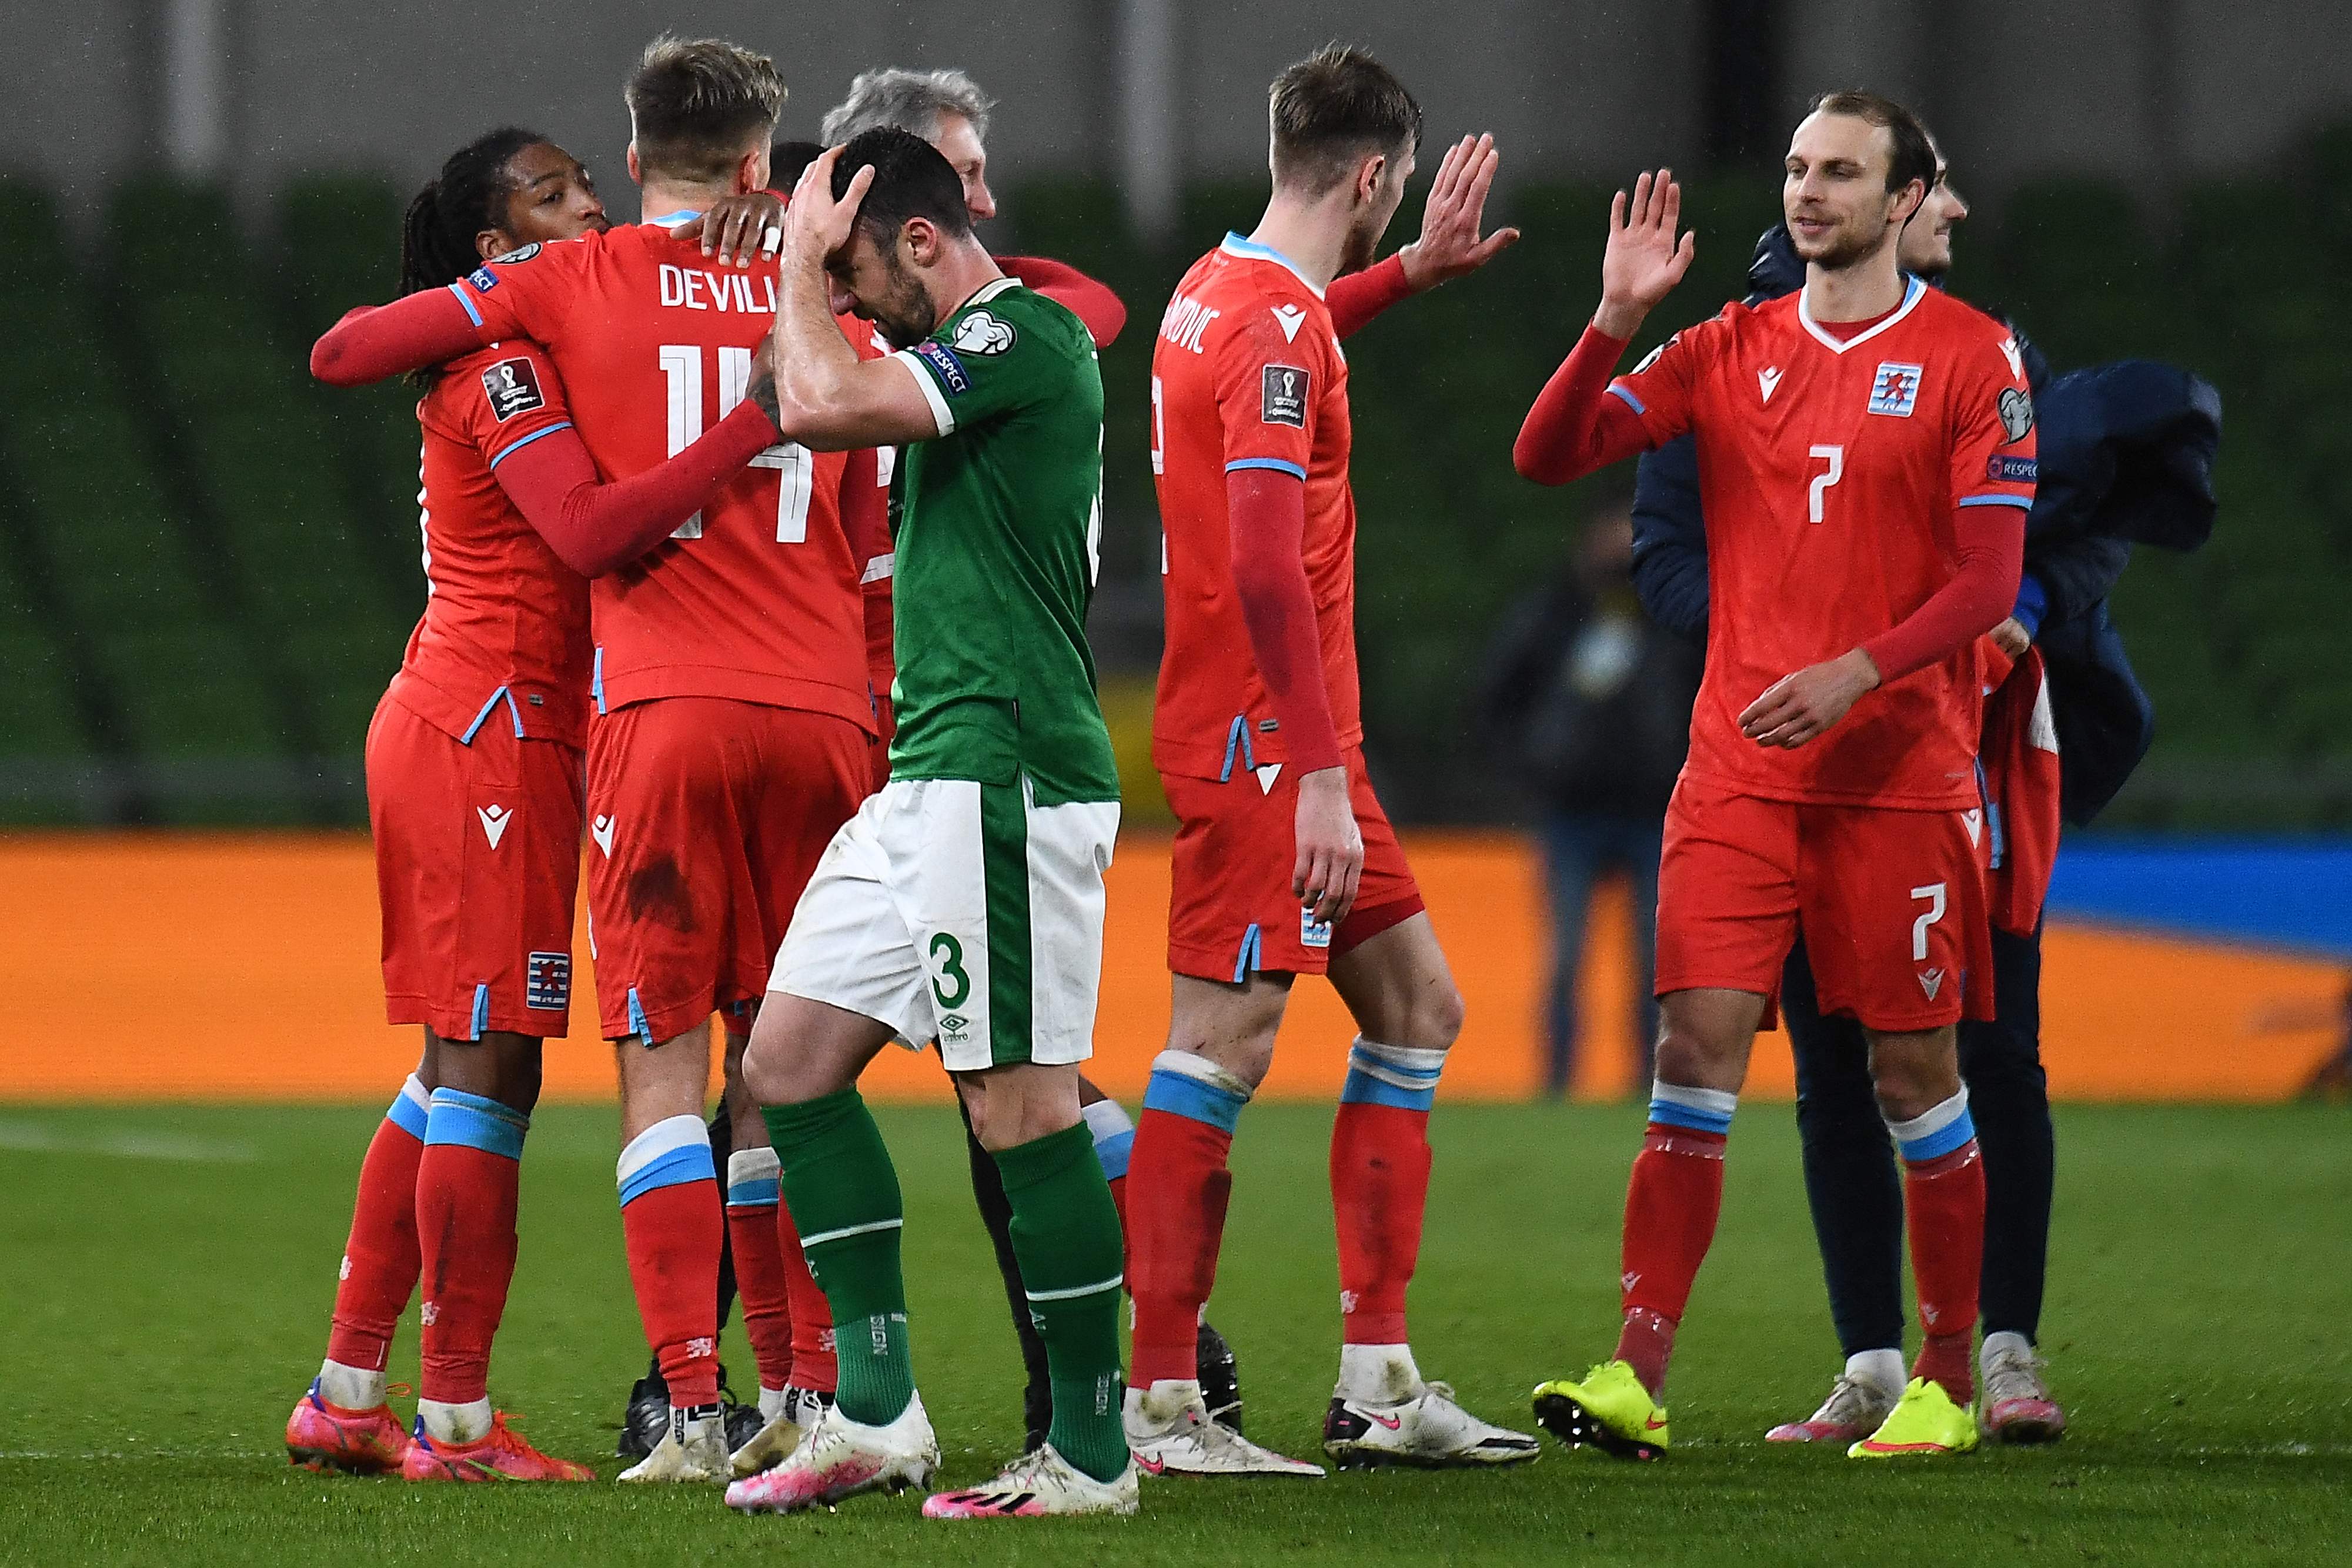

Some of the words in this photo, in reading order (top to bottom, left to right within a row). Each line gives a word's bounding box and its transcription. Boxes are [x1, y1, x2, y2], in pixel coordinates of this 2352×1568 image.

[930, 349, 967, 393] RESPECT
[1809, 443, 1844, 523] 7
[1911, 882, 1947, 961] 7
[930, 932, 970, 1009] 3
